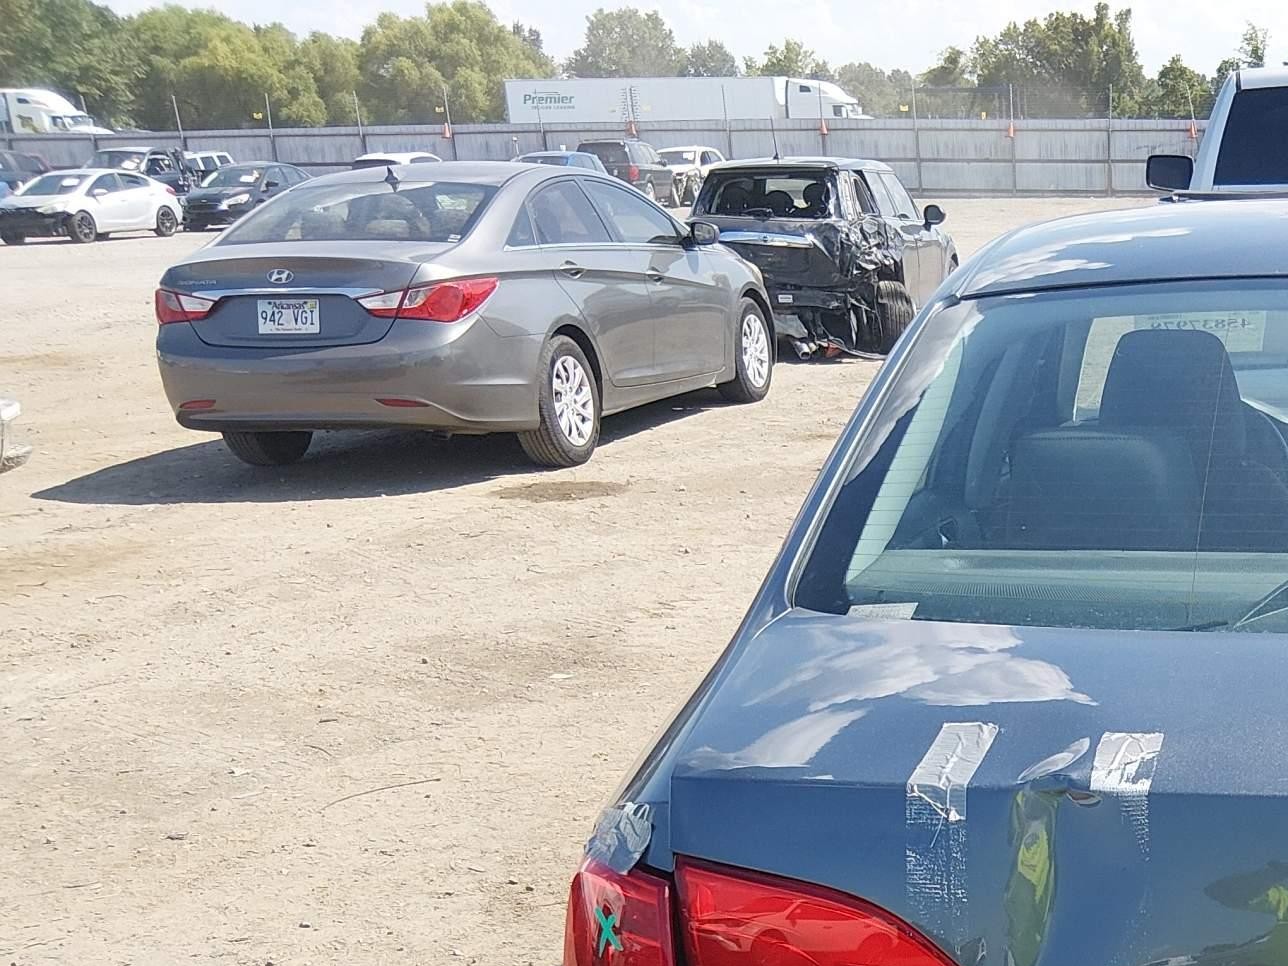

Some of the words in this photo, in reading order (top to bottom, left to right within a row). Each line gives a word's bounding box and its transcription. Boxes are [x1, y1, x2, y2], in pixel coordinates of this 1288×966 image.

[523, 94, 575, 104] Premier
[271, 301, 306, 310] Arkansas
[261, 310, 284, 326] 942
[292, 310, 315, 325] VGI
